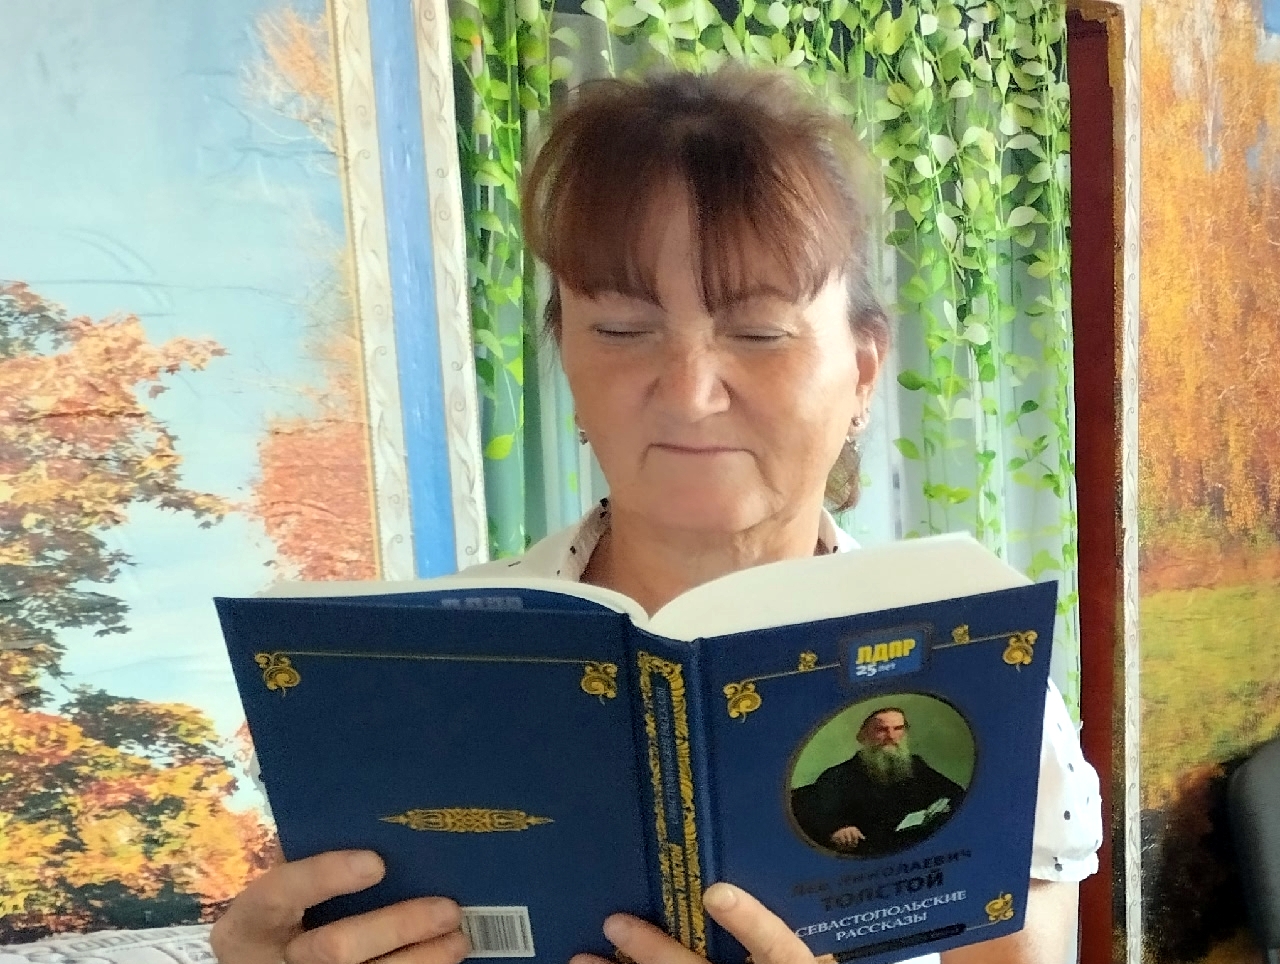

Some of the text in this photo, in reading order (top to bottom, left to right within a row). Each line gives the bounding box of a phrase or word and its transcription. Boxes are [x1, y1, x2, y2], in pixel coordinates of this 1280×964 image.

[855, 638, 916, 665] ЛДПР
[855, 664, 878, 677] 25
[822, 869, 944, 912] ТОЛСТОЙ
[795, 889, 968, 939] СЕВАСТОПОЛЬСКИЕ
[835, 911, 928, 941] РАССКАЗЫ
